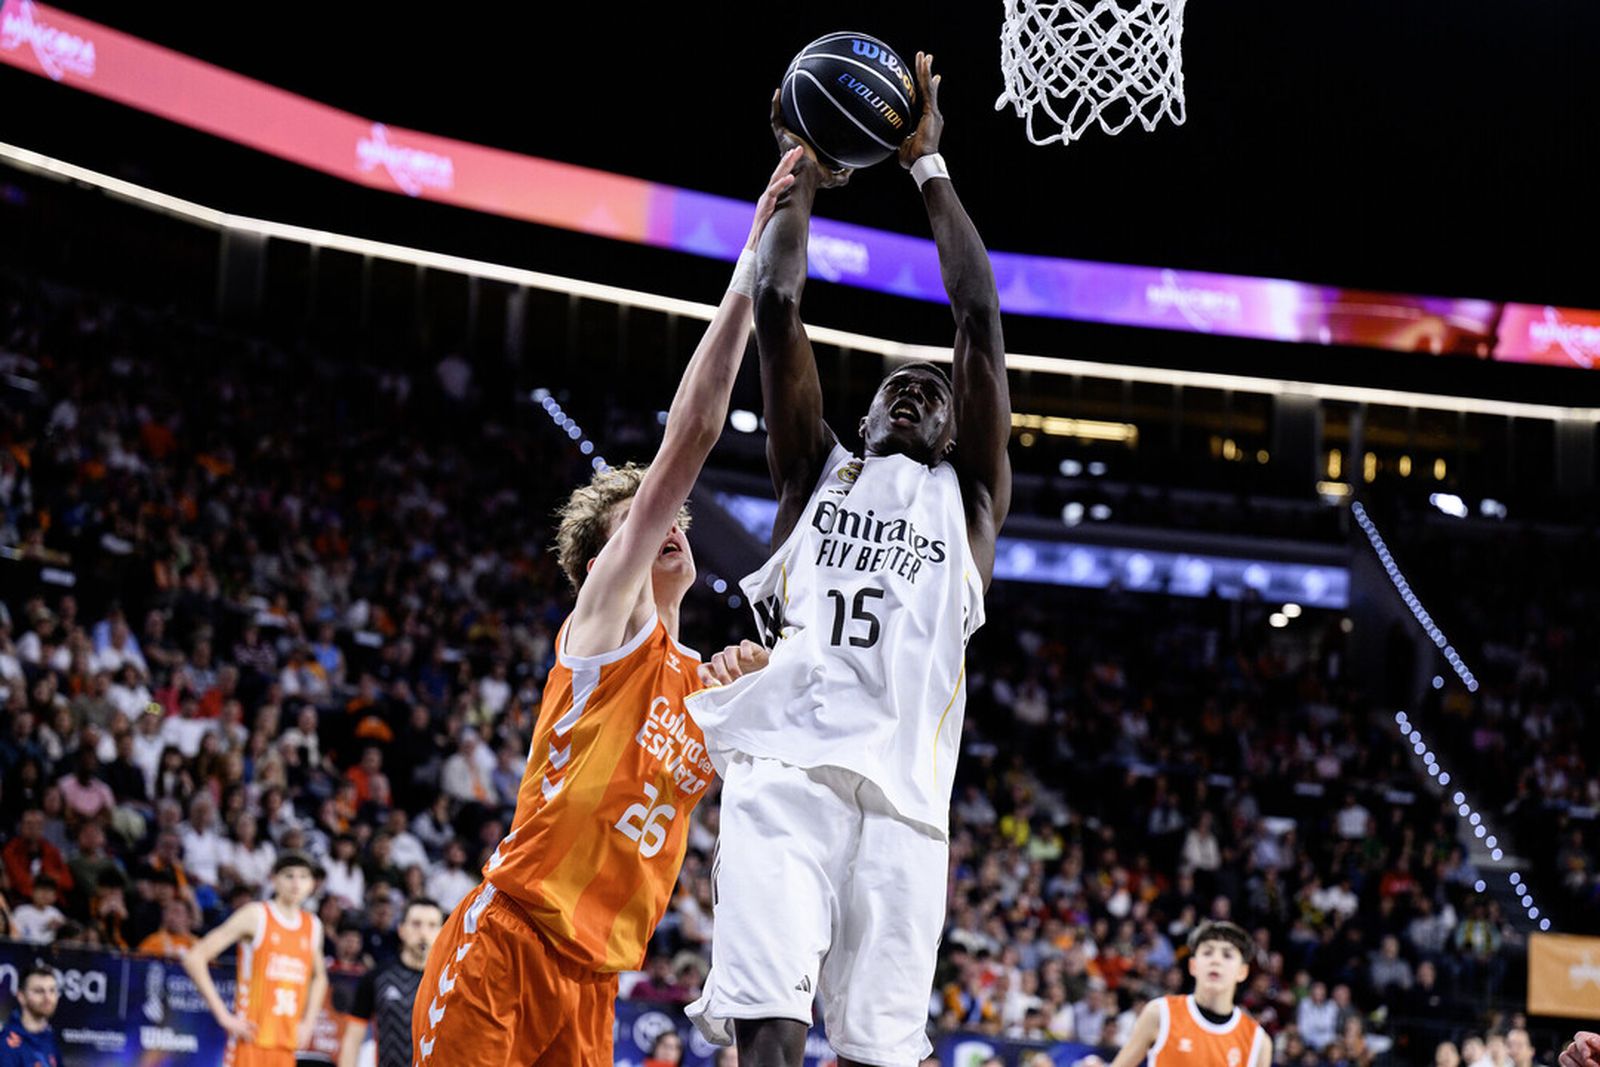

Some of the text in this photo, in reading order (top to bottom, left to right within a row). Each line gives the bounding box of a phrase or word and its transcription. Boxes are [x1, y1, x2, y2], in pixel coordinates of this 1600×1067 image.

[837, 73, 903, 129] EVOLUTION
[812, 501, 946, 563] Emirates
[815, 539, 853, 568] FLY
[827, 588, 884, 648] 15
[635, 720, 706, 795] ESFUZO
[650, 696, 704, 763] Culura
[614, 781, 677, 859] 26
